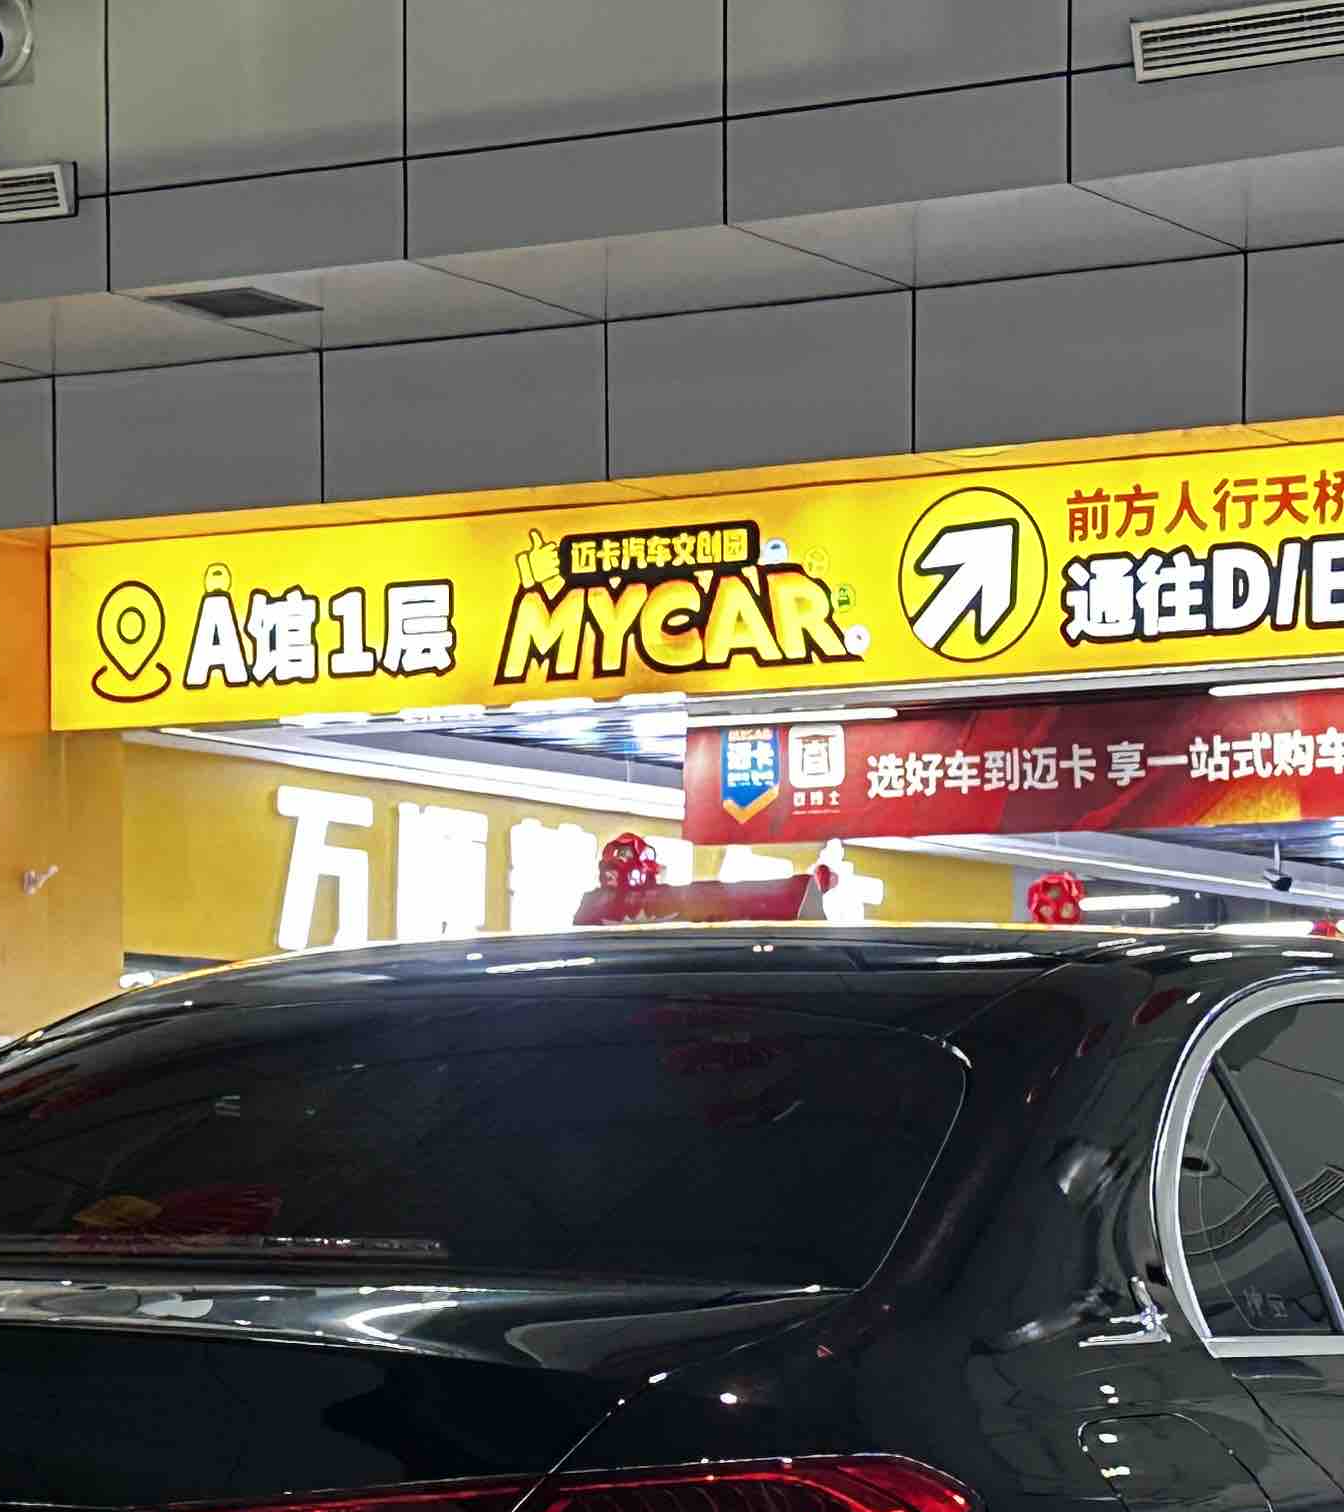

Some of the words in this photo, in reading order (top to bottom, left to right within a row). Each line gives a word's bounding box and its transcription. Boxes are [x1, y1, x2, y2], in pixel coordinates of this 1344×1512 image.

[570, 529, 750, 576] 迈卡汽车文创园
[184, 580, 454, 690] A馆1层
[495, 569, 864, 686] MYCAR
[866, 741, 1098, 800] 选好车到迈卡
